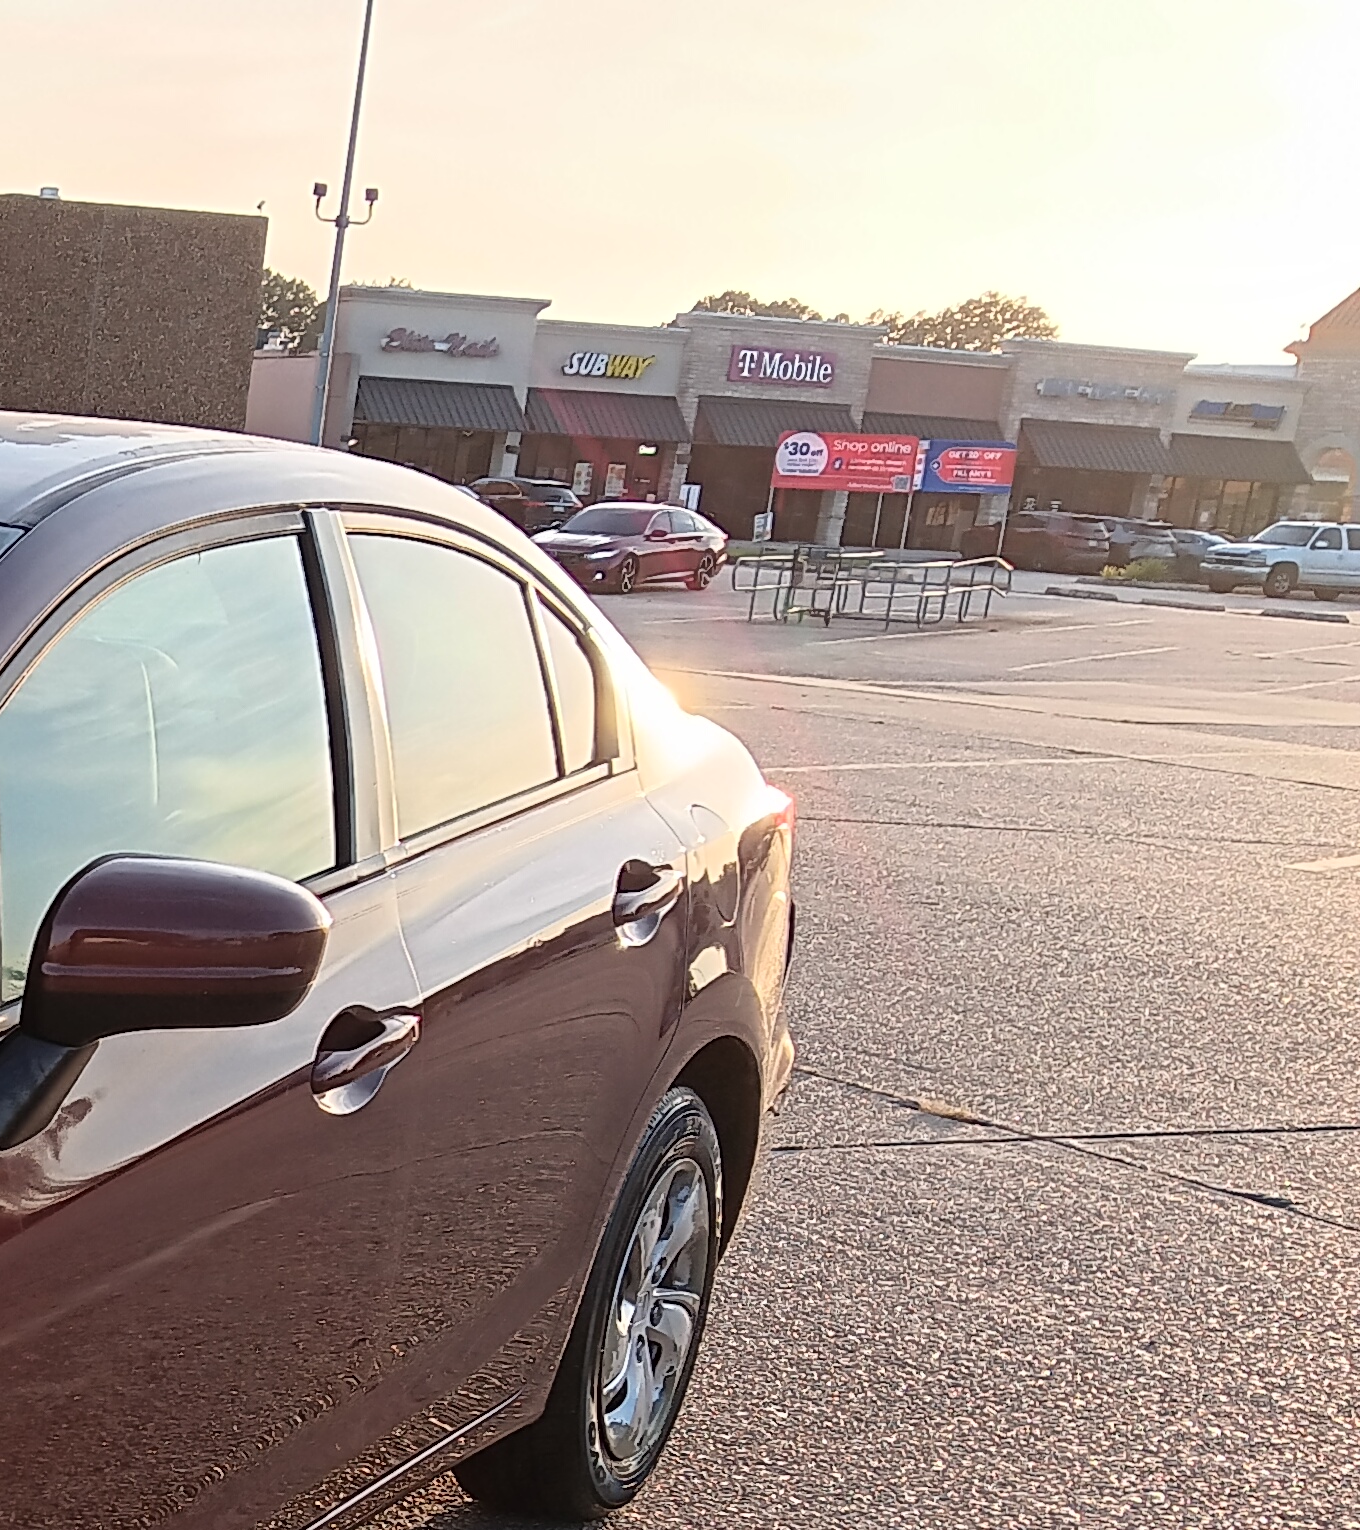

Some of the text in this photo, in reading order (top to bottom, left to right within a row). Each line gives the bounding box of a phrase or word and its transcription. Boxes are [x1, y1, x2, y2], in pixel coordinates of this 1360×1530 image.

[562, 352, 657, 379] SUBWAY
[783, 441, 810, 456] $30
[833, 438, 912, 455] Shop online
